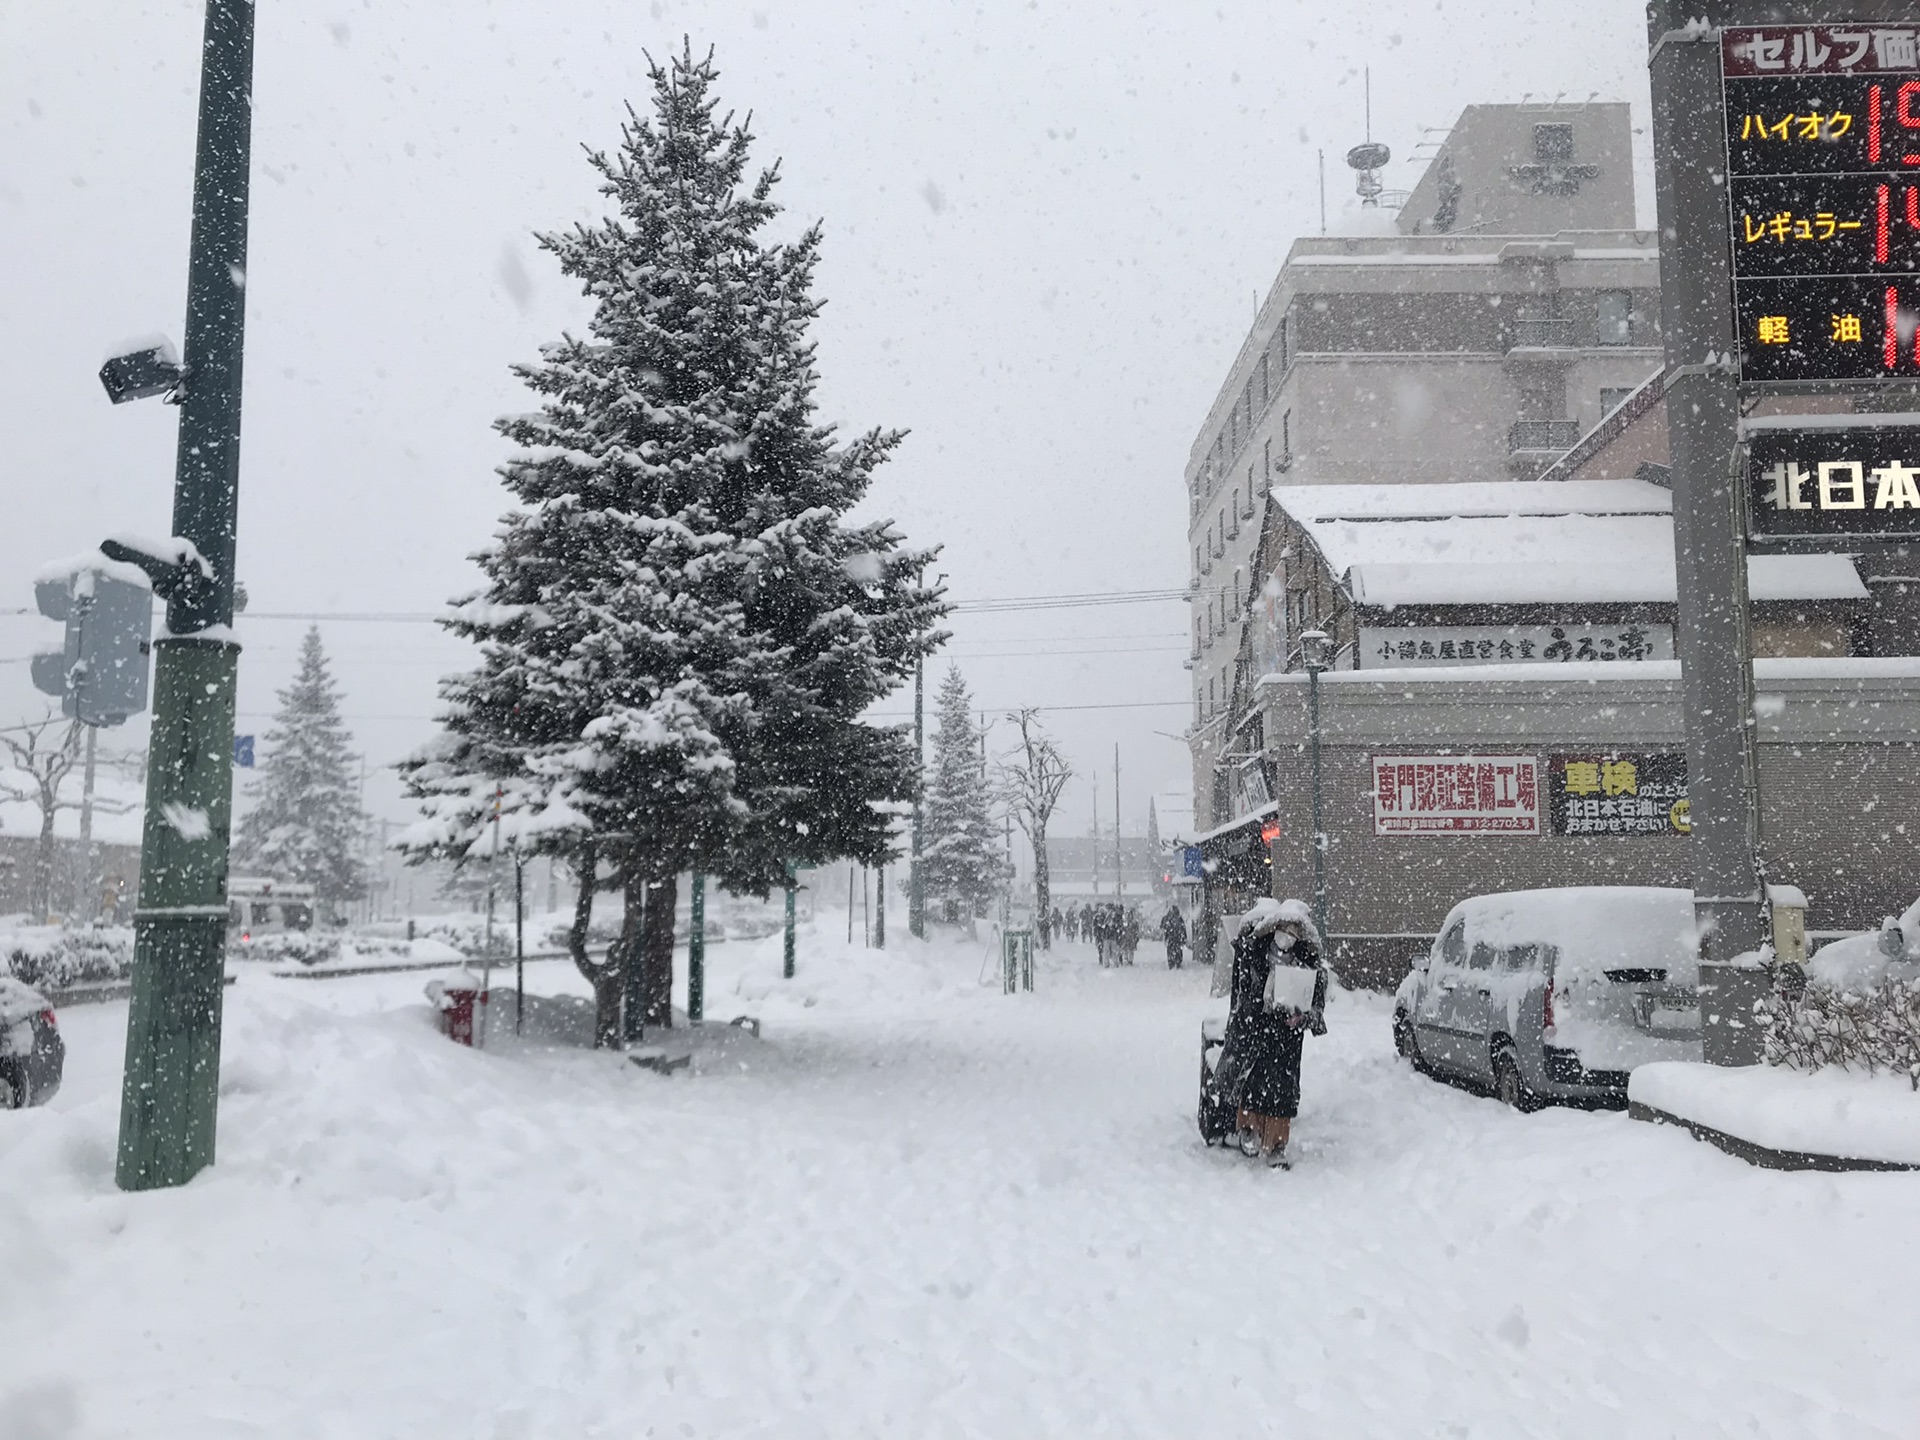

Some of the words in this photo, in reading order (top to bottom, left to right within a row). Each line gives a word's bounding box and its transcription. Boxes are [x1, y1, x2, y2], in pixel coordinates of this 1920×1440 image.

[1747, 29, 1920, 69] セルフ価
[1742, 111, 1852, 140] ハイオク
[1744, 211, 1862, 243] レギュラー
[1877, 184, 1920, 264] 1
[1885, 285, 1920, 368] 1
[1761, 459, 1920, 510] 北日本
[1377, 638, 1536, 660] 小樽魚屋直営食堂
[1377, 763, 1535, 811] 専門認証整備工場
[1565, 761, 1637, 796] 車検
[1565, 799, 1667, 817] 北日本石油に
